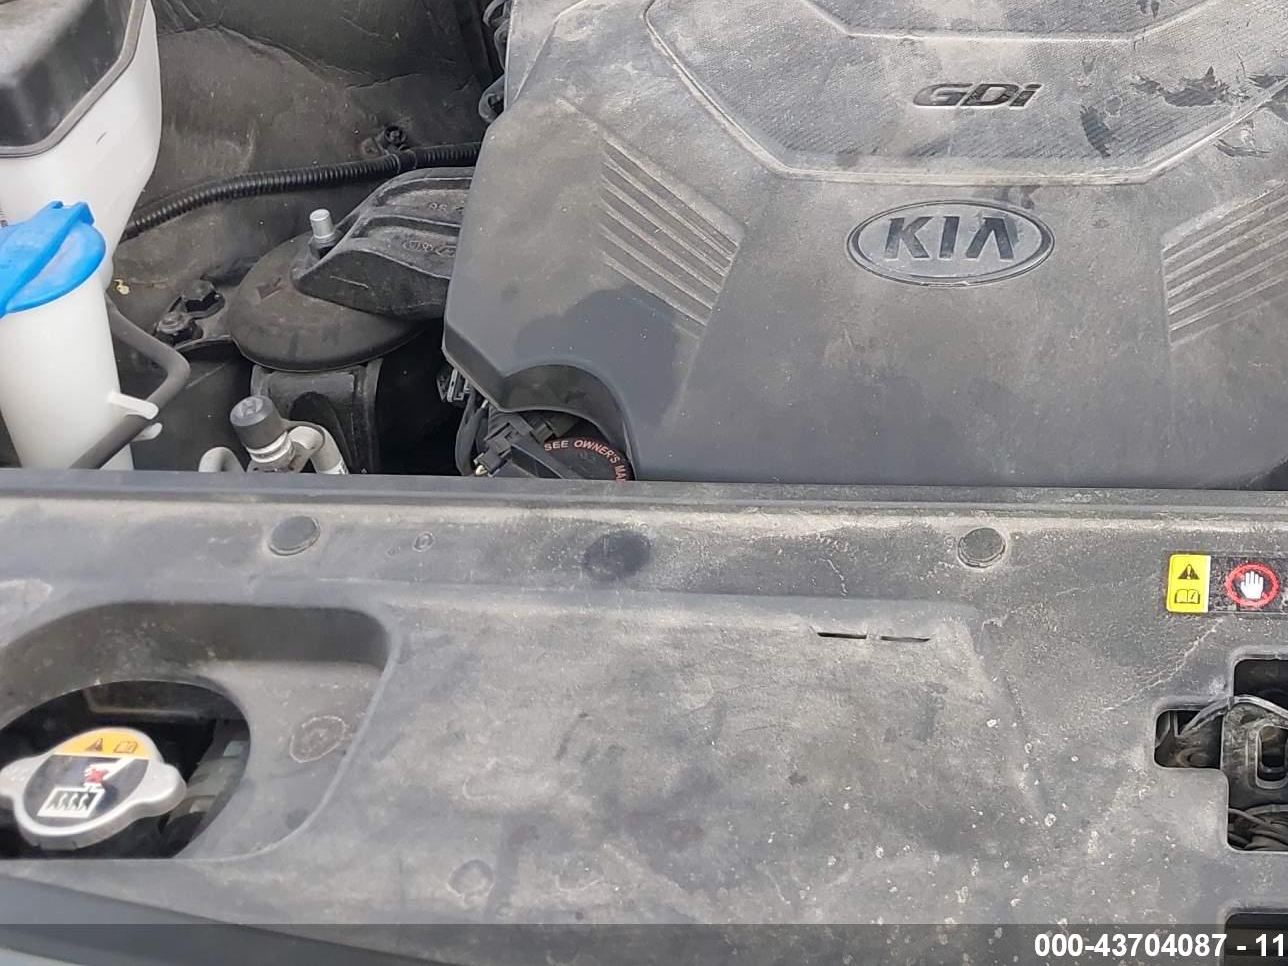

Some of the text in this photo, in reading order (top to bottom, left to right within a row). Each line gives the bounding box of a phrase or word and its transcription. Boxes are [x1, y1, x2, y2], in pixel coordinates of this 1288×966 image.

[884, 216, 1015, 261] KIA
[544, 440, 569, 451] SEE
[574, 440, 620, 464] OWNER'S
